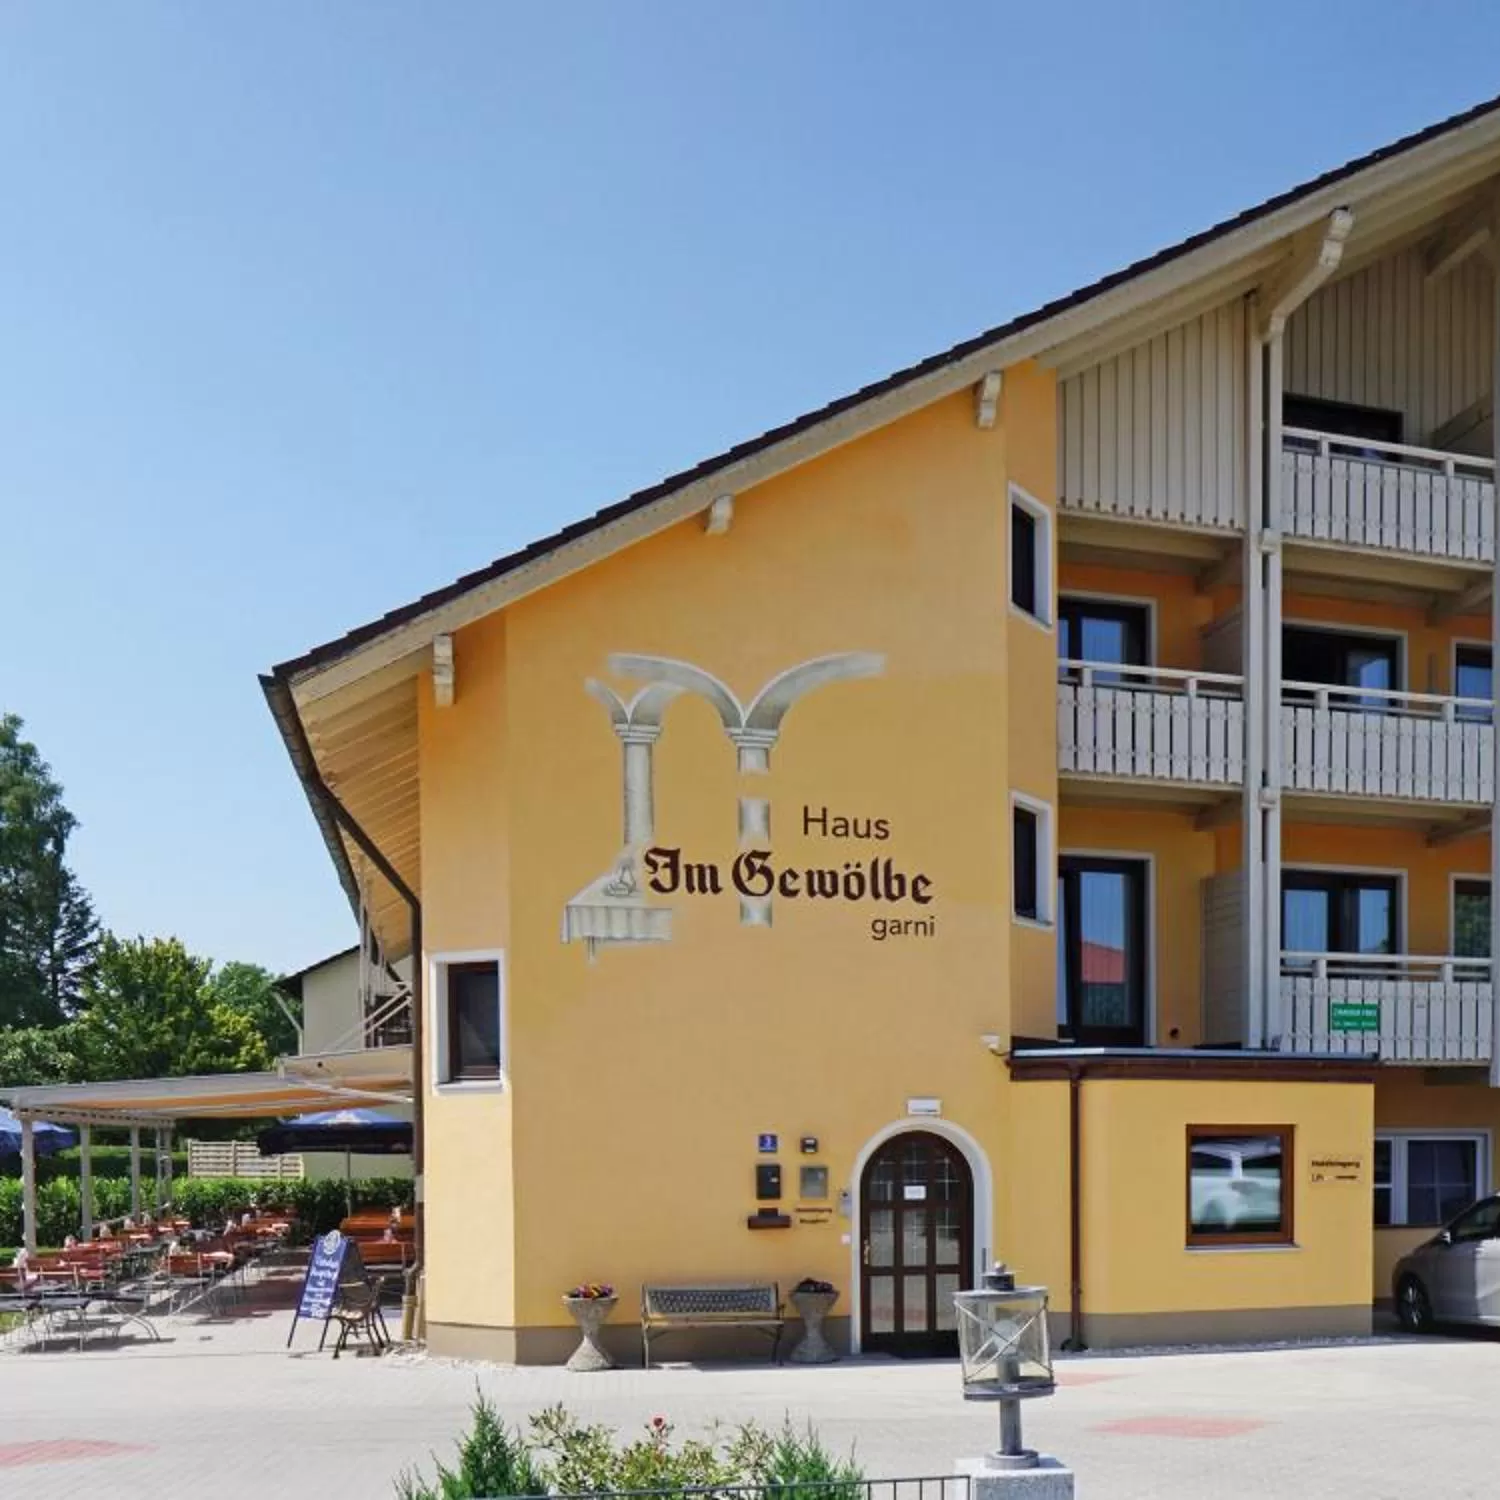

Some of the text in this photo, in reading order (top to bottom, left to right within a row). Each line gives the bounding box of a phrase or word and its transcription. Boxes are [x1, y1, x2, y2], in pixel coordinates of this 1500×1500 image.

[803, 805, 891, 840] Haus
[644, 847, 934, 905] Im Gewölbe
[871, 915, 936, 941] garni
